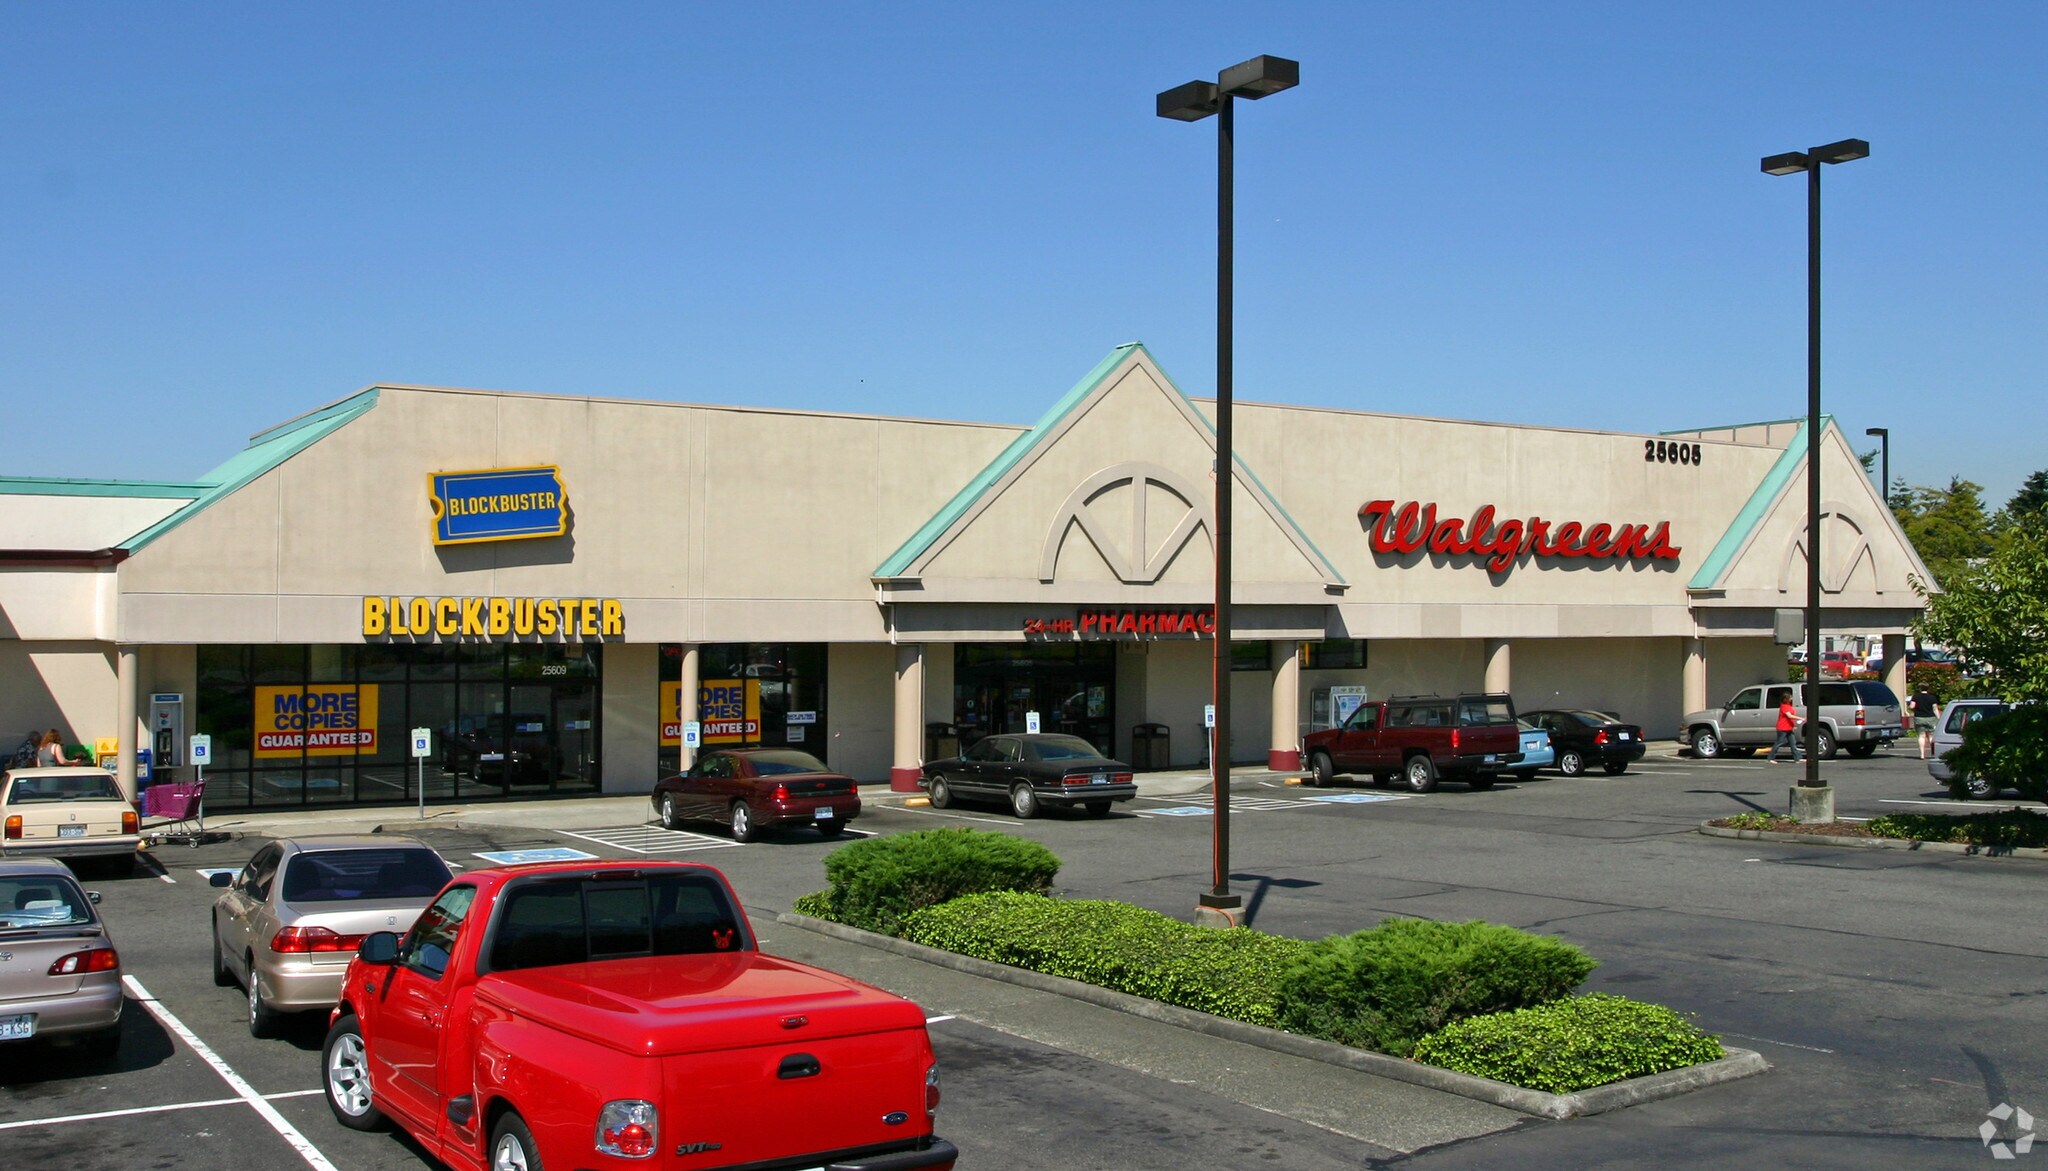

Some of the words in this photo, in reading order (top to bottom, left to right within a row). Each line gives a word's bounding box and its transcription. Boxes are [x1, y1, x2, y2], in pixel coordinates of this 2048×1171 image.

[1645, 440, 1701, 466] 25605
[449, 492, 556, 516] BLOCKBUSTER
[1359, 500, 1682, 573] Walgreens
[363, 597, 622, 635] BLOCKBUSTER
[1081, 612, 1216, 633] PHARMAC
[542, 665, 567, 675] 25609
[274, 693, 358, 713] MORE
[676, 705, 742, 721] PIES
[274, 713, 357, 730] COPIES
[665, 723, 756, 736] GUANTEED
[675, 1142, 706, 1155] SVT
